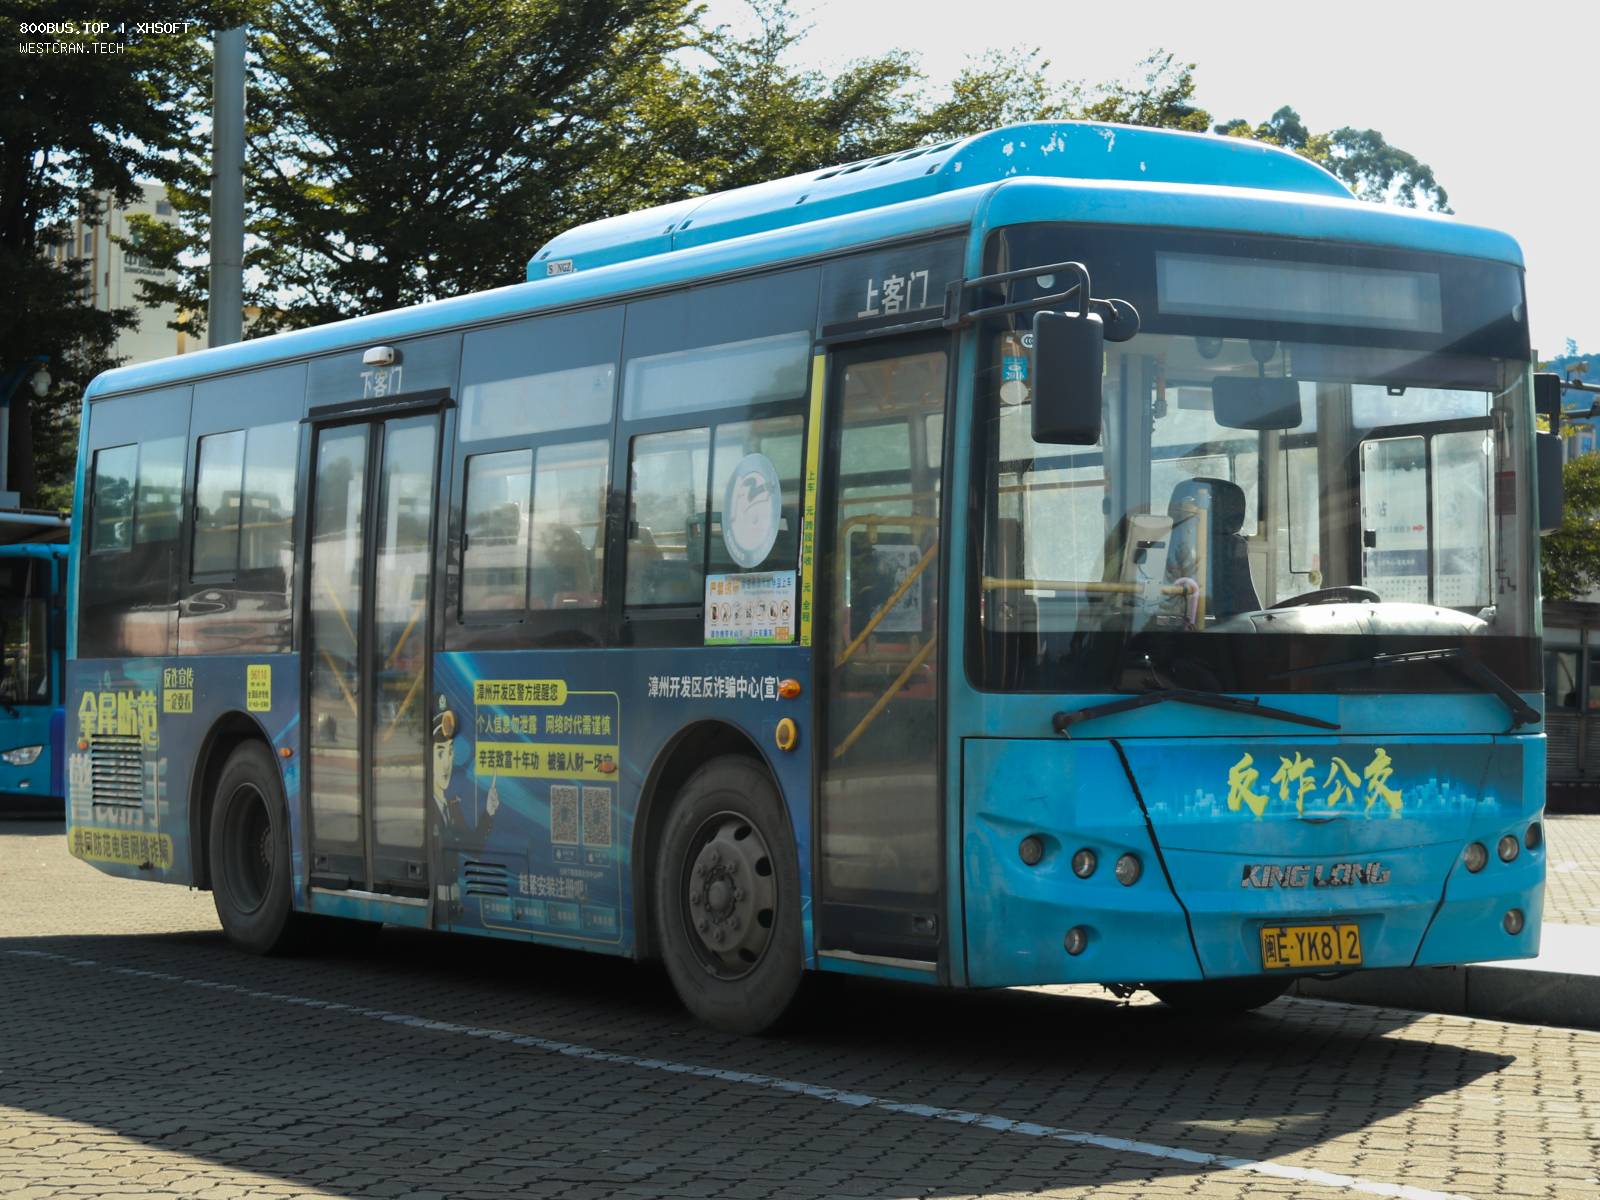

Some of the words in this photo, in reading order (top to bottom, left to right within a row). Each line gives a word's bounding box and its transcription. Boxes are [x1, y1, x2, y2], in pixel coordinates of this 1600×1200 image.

[857, 270, 929, 319] 上客门
[360, 365, 402, 399] 下客门
[477, 684, 558, 702] 漳州开发区警方提醒您
[648, 676, 780, 701] 漳州开发区反诈骗中心(宣)
[477, 714, 537, 735] 个人信息勿泄露
[545, 715, 611, 736] 网络时代需谨慎
[479, 752, 539, 770] 辛苦致富十年功
[1227, 748, 1403, 818] 反诈公交
[1241, 864, 1310, 888] KING
[1313, 863, 1390, 886] LONG
